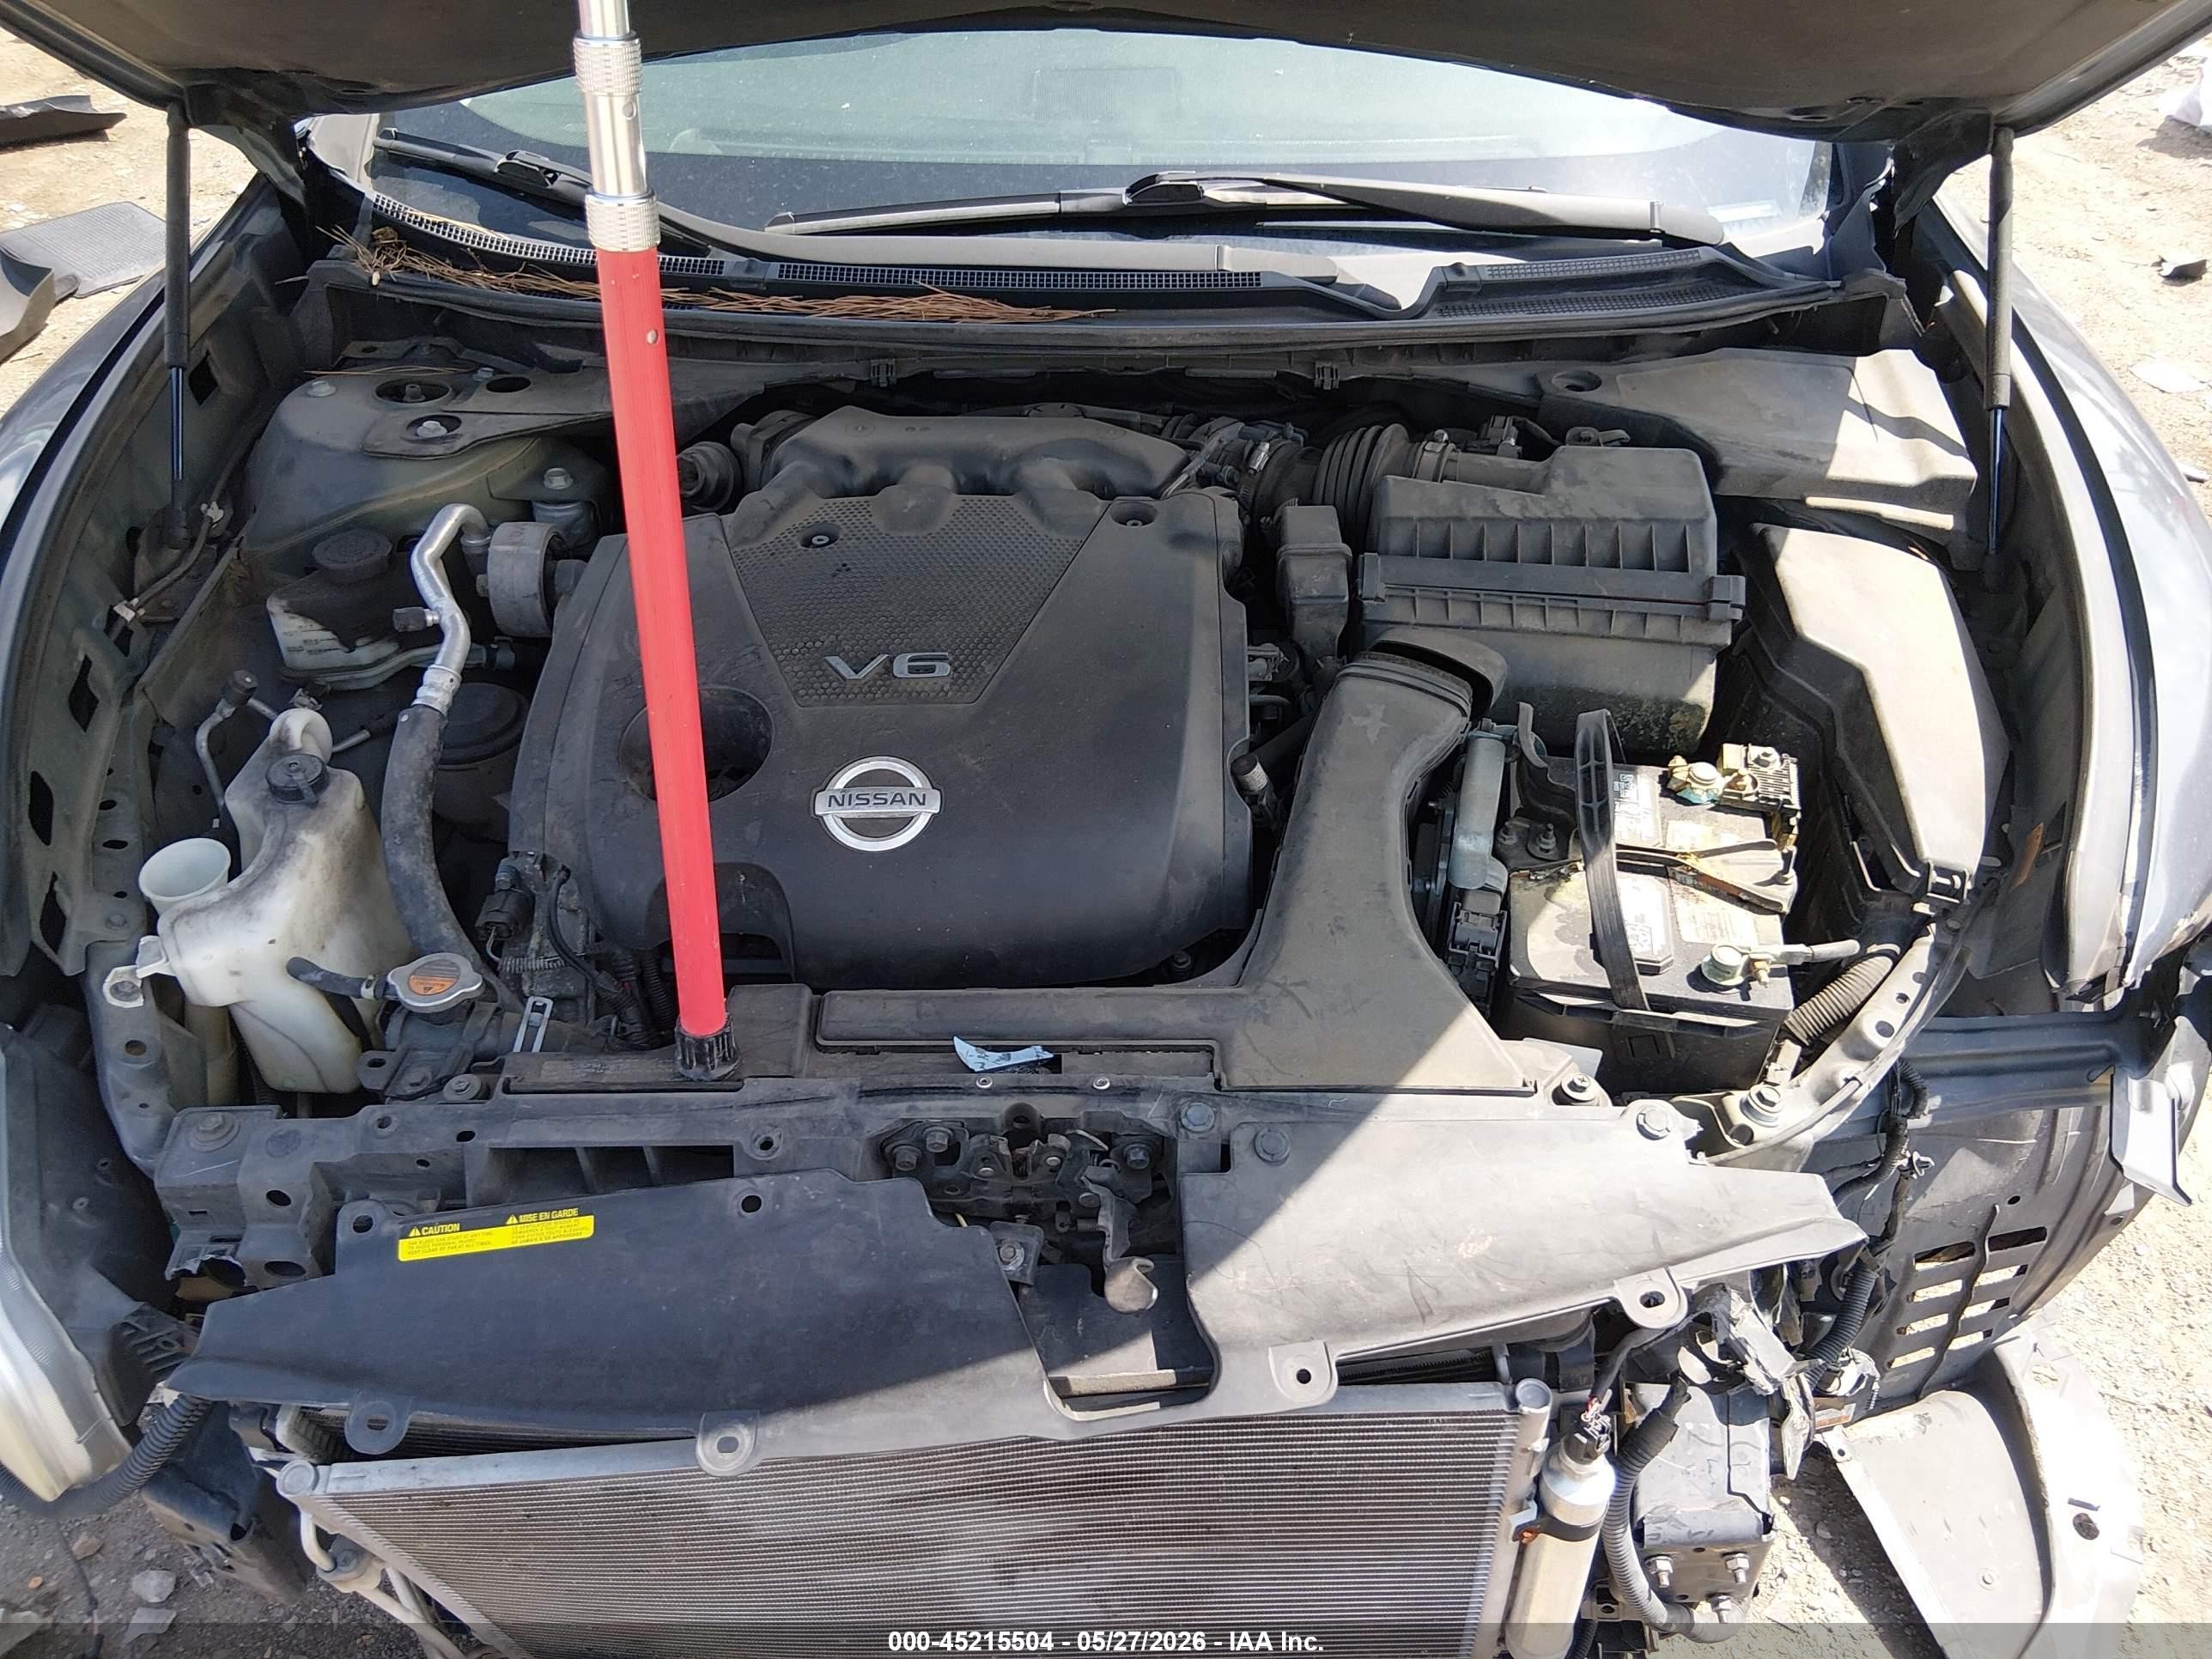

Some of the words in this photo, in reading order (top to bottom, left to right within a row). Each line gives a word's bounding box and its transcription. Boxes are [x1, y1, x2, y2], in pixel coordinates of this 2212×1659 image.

[824, 652, 951, 680] V6
[828, 792, 927, 808] NISSAN
[519, 1212, 538, 1223] MISE
[539, 1212, 550, 1220] EN
[551, 1207, 579, 1219] GARDE
[422, 1223, 460, 1236] CAUTION
